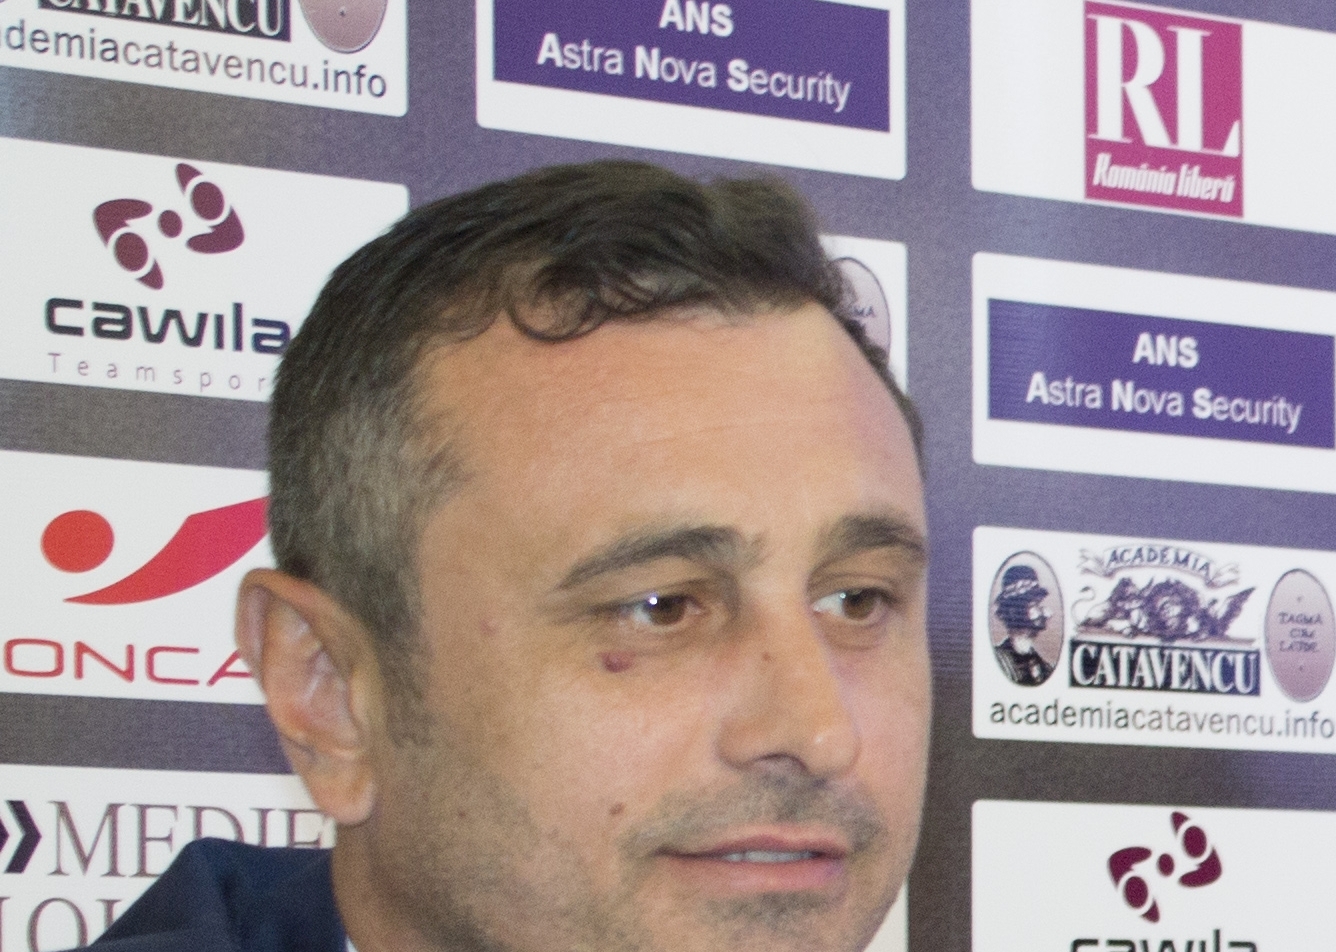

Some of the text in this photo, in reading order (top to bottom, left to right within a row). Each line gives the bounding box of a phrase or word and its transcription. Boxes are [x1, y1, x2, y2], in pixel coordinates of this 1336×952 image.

[660, 0, 734, 37] ANS
[0, 19, 387, 98] demiacatavencu.info
[537, 33, 852, 113] Astra Nova Security
[1086, 14, 1240, 157] RL
[44, 297, 291, 355] cawila
[1133, 332, 1199, 368] ANS
[1025, 371, 1302, 434] Astra Nova Security
[1107, 547, 1212, 578] ACADEMIA
[1072, 643, 1257, 694] CATAVENCU
[989, 699, 1335, 739] academiacatavencu.info
